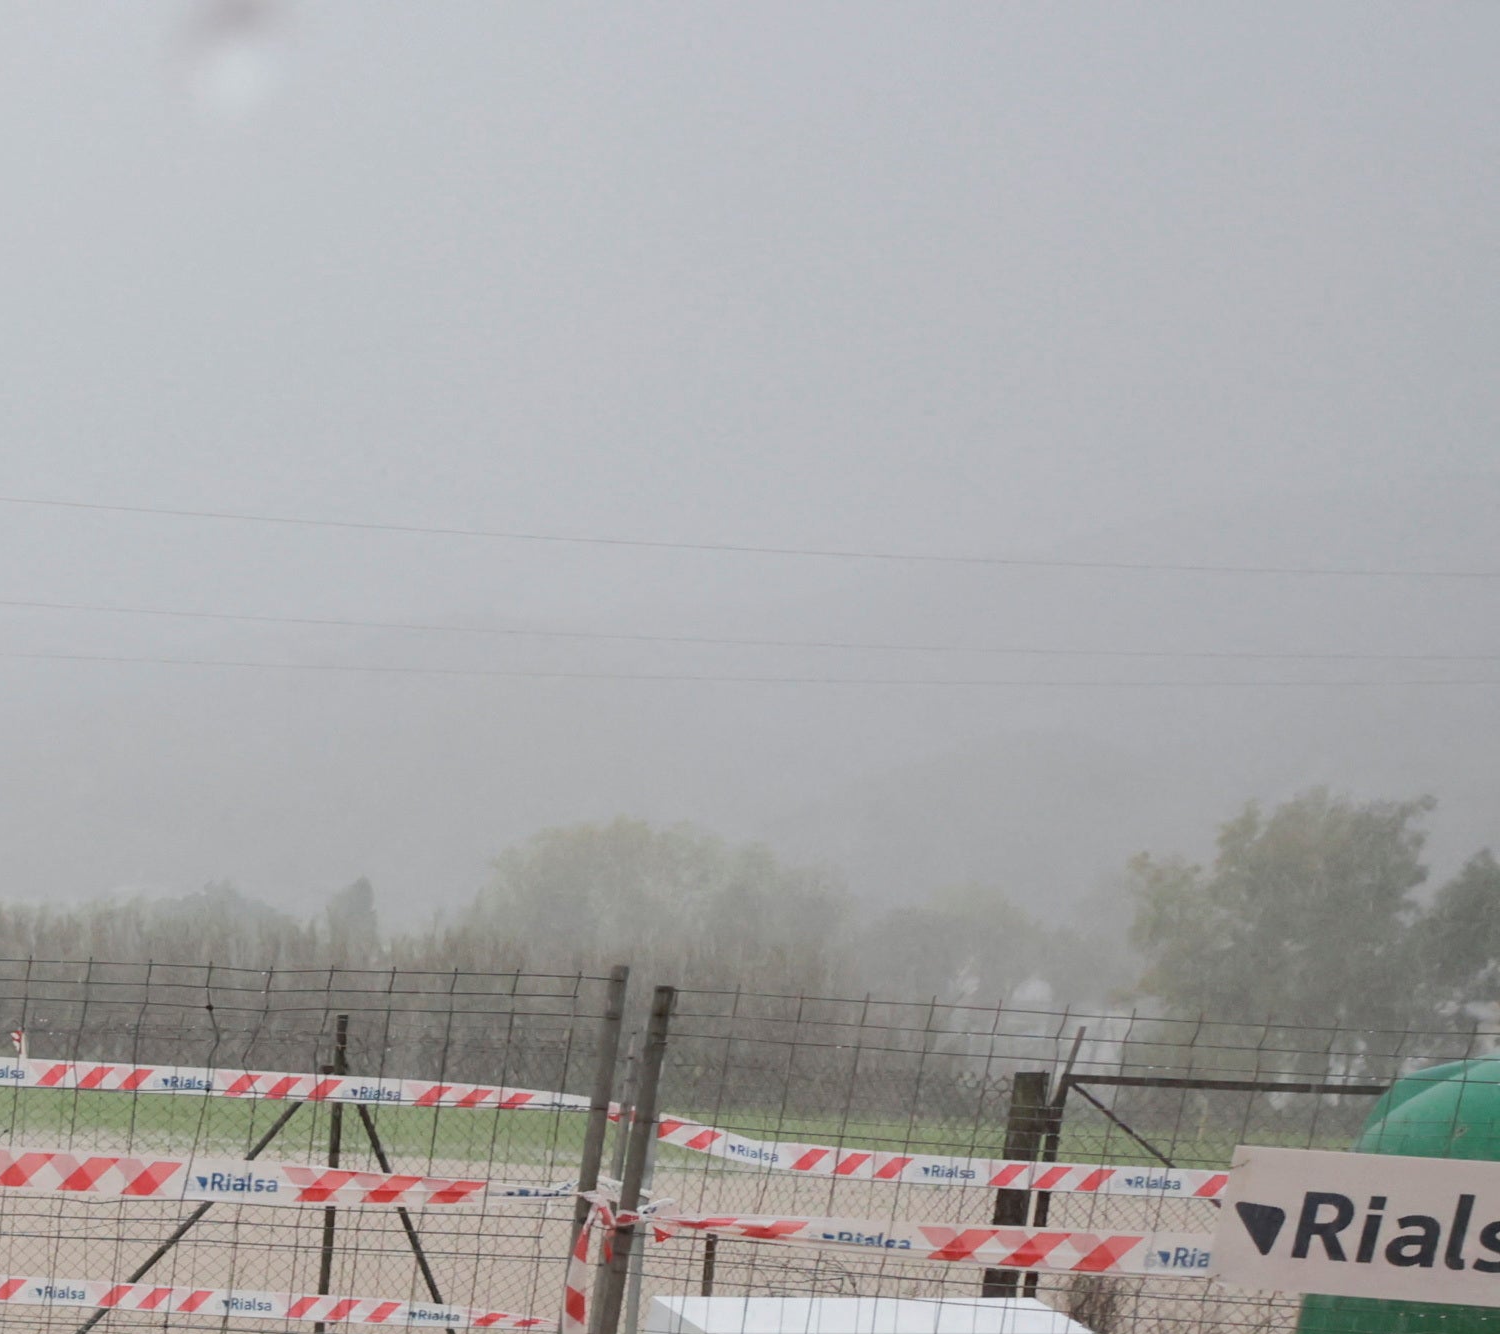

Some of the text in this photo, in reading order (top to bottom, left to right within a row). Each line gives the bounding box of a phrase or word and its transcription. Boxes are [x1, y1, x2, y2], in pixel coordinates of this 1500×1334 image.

[170, 1075, 214, 1091] Rialsa
[359, 1085, 402, 1101] Rialsa
[738, 1143, 780, 1163] Rialsa
[931, 1164, 976, 1180] Rialsa
[211, 1172, 279, 1194] Rialsa
[1134, 1174, 1182, 1191] Rialsa
[43, 1284, 86, 1301] Rialsa
[230, 1296, 273, 1312] Rialsa
[418, 1308, 460, 1323] Rialsa
